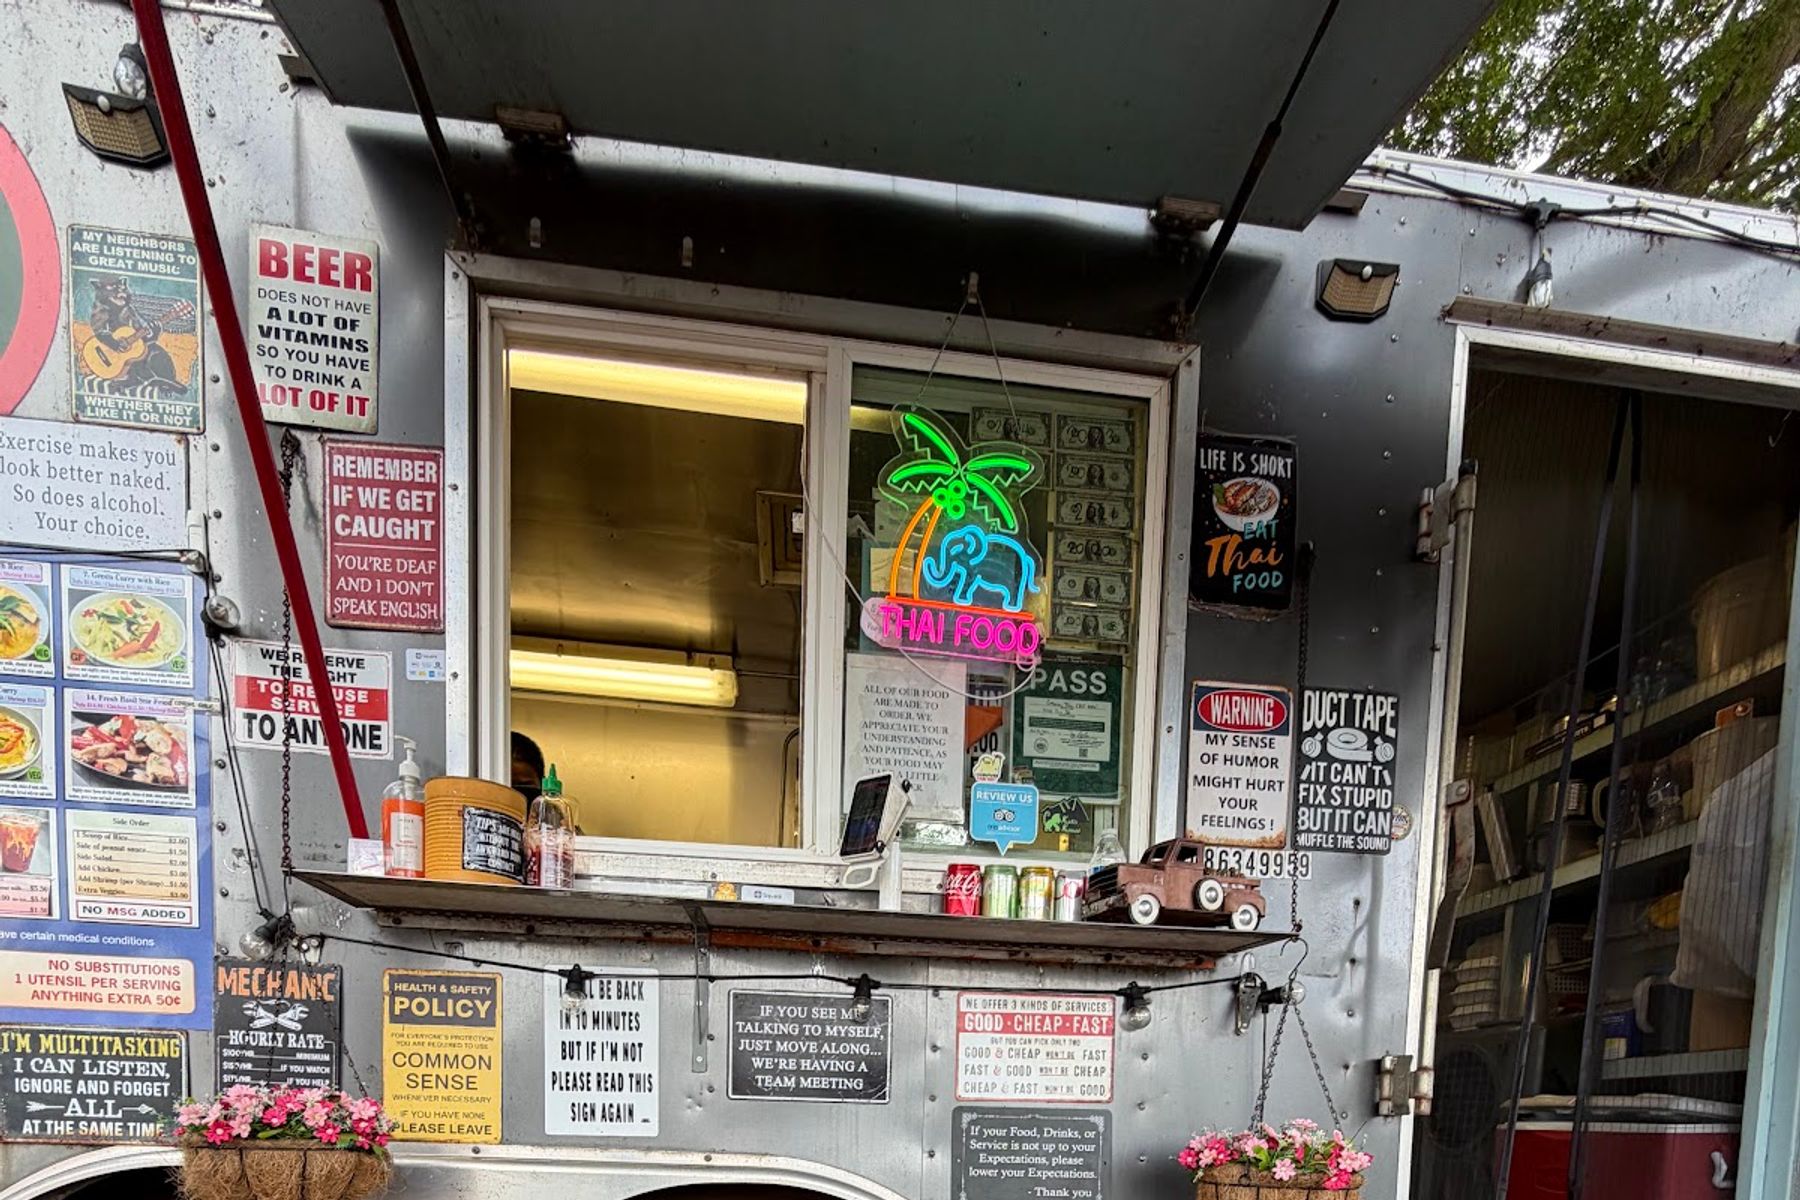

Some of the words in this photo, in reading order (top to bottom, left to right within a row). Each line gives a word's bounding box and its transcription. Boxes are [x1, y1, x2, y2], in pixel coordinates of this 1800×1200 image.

[83, 231, 103, 241] MY
[107, 234, 185, 252] NEIGHBORS
[72, 242, 99, 253] ARE
[103, 246, 174, 262] LISTENING
[178, 254, 196, 265] TO
[89, 256, 134, 269] GREAT
[138, 262, 180, 275] MUSIC
[259, 239, 372, 292] BEER
[258, 288, 297, 303] DOES
[302, 294, 330, 308] NOT
[335, 300, 371, 314] HAVE
[267, 307, 281, 320] A
[288, 309, 327, 327] LOT
[334, 316, 361, 332] OF
[258, 325, 368, 353] VITAMINS
[256, 344, 279, 358] SO
[285, 348, 319, 364] YOU
[326, 355, 370, 371] HAVE
[264, 365, 286, 378] TO
[293, 369, 345, 387] DRINK
[351, 378, 362, 390] A
[84, 396, 153, 411] WHETHER
[156, 403, 193, 415] THEY
[259, 383, 302, 407] LOT
[309, 390, 340, 412] OF
[346, 395, 369, 416] IT
[86, 407, 119, 418] LIKE
[122, 410, 136, 419] IT
[140, 413, 160, 423] OR
[163, 415, 192, 426] NOT
[80, 441, 138, 462] makes
[144, 450, 176, 469] you
[1200, 448, 1226, 472] LIFE
[1233, 452, 1245, 473] IS
[1251, 454, 1293, 479] SHORT
[0, 457, 40, 477] look
[47, 461, 102, 483] better
[110, 470, 170, 490] naked.
[333, 455, 437, 483] REMEMBER
[13, 483, 34, 502] So
[42, 487, 84, 507] does
[91, 492, 164, 515] alcohol.
[333, 485, 353, 506] IF
[357, 487, 390, 510] WE
[396, 490, 436, 513] GET
[35, 512, 77, 533] Your
[84, 517, 150, 539] choice.
[335, 514, 435, 541] CAUGHT
[1244, 519, 1279, 540] EAT
[335, 555, 392, 572] YOU'RE
[396, 560, 436, 574] DEAF
[1205, 534, 1283, 578] Thai
[336, 577, 372, 592] AND
[376, 580, 381, 593] I
[386, 580, 434, 597] DON'T
[1233, 571, 1283, 593] FOOD
[334, 597, 377, 615] SPEAK
[381, 601, 438, 619] ENGLISH
[879, 604, 944, 644] THAI
[954, 614, 1039, 655] FOOD
[1030, 668, 1107, 695] PASS
[1211, 694, 1274, 727] WARNING
[1303, 690, 1349, 732] DUCT
[1353, 694, 1397, 738] TAPE
[1206, 734, 1228, 746] MY
[1232, 736, 1276, 750] SENSE
[1200, 753, 1219, 765] OF
[1224, 754, 1279, 769] HUMOR
[1193, 775, 1241, 790] MIGHT
[1246, 777, 1285, 791] HURT
[1311, 761, 1328, 782] IT
[1331, 762, 1382, 785] CAN'T
[976, 791, 1016, 801] REVIEW
[1020, 792, 1032, 803] US
[1219, 797, 1258, 811] YOUR
[1299, 783, 1327, 805] FIX
[1330, 785, 1392, 809] STUPID
[1298, 807, 1333, 832] BUT
[1335, 809, 1351, 832] IT
[1353, 810, 1391, 835] CAN
[1297, 833, 1334, 847] MUFFLE
[1337, 835, 1355, 848] THE
[1357, 836, 1389, 850] SOUND
[1205, 848, 1309, 877] 86349959
[82, 906, 102, 914] NO
[107, 907, 137, 916] MSG
[142, 909, 185, 919] ADDED
[20, 933, 55, 941] certain
[58, 933, 100, 943] medical
[49, 960, 69, 971] NO
[75, 961, 180, 976] SUBSTITUTIONS
[15, 974, 22, 984] 1
[28, 975, 85, 987] UTENSIL
[91, 977, 117, 988] PER
[123, 978, 181, 991] SERVING
[217, 966, 336, 1001] MECHANIC
[394, 982, 436, 993] HEALTH
[439, 985, 447, 993] &
[450, 984, 491, 994] SAFETY
[31, 990, 103, 1003] ANYTHING
[107, 993, 151, 1005] EXTRA
[156, 994, 181, 1006] 50¢
[394, 997, 491, 1019] POLICY
[736, 1021, 799, 1035] TALKING
[803, 1025, 821, 1036] TO
[825, 1026, 884, 1040] MYSELF,
[964, 1013, 1004, 1031] GOOD
[1014, 1016, 1062, 1032] CHEAP
[1073, 1017, 1109, 1034] FAST
[1, 1032, 31, 1052] I'M
[39, 1034, 180, 1058] MULTITASKING
[229, 1030, 284, 1047] HOURLY
[287, 1033, 324, 1049] RATE
[738, 1040, 772, 1050] JUST
[776, 1041, 817, 1053] MOVE
[821, 1043, 881, 1055] ALONG...
[393, 1052, 492, 1070] COMMON
[561, 1041, 581, 1060] BUT
[587, 1042, 596, 1061] IF
[602, 1042, 618, 1061] I'M
[623, 1043, 643, 1062] NOT
[13, 1058, 23, 1073] I
[30, 1058, 75, 1074] CAN
[83, 1059, 170, 1079] LISTEN,
[15, 1078, 72, 1094] IGNORE
[77, 1080, 109, 1095] AND
[114, 1081, 170, 1097] FORGET
[406, 1073, 478, 1091] SENSE
[552, 1071, 591, 1091] PLEASE
[597, 1073, 623, 1092] READ
[629, 1073, 653, 1093] THIS
[63, 1098, 123, 1118] ALL
[570, 1102, 596, 1122] SIGN
[601, 1103, 634, 1123] AGAIN
[22, 1119, 40, 1135] AT
[44, 1120, 73, 1135] THE
[79, 1122, 123, 1136] SAME
[393, 1122, 445, 1134] PLEASE
[450, 1124, 492, 1135] LEAVE
[970, 1126, 980, 1136] If
[983, 1128, 1007, 1137] your
[1010, 1127, 1040, 1138] Food,
[1044, 1128, 1081, 1139] Drinks,
